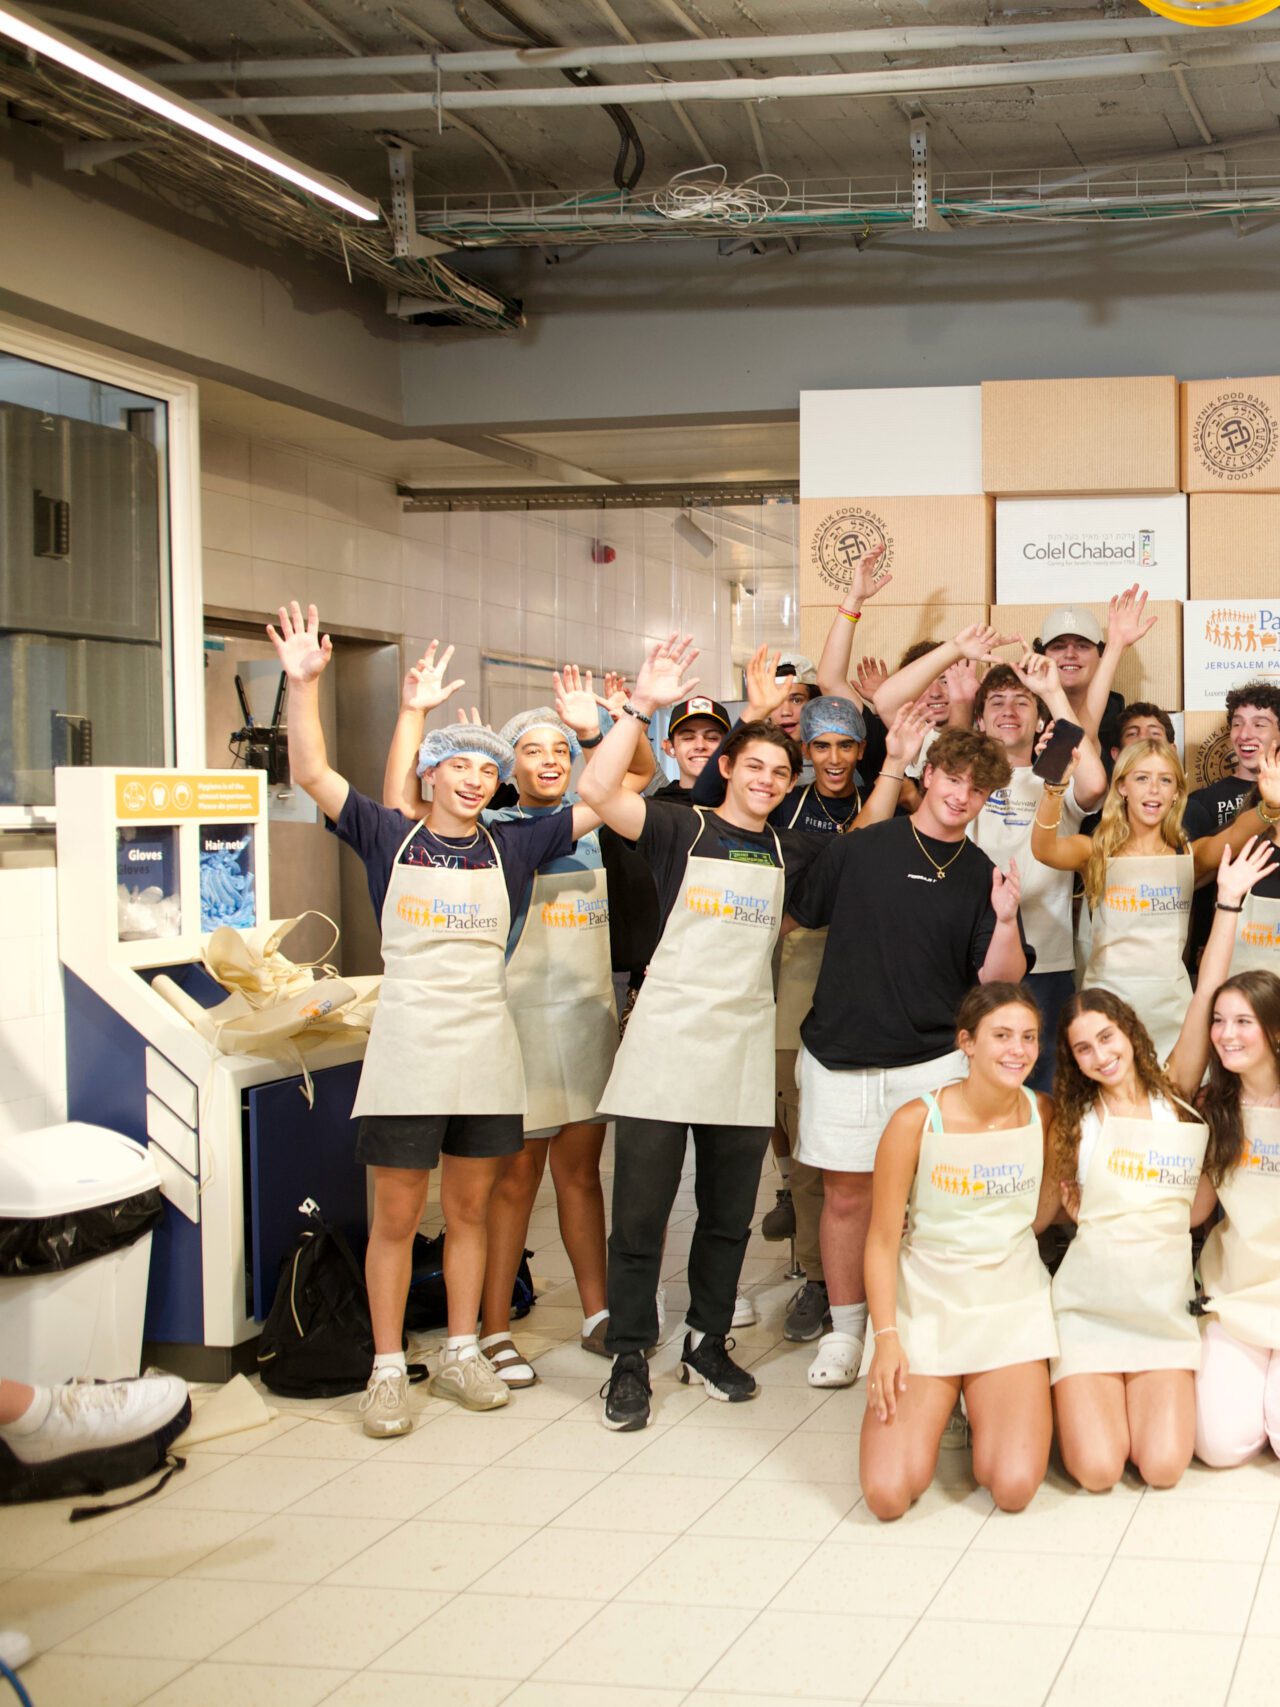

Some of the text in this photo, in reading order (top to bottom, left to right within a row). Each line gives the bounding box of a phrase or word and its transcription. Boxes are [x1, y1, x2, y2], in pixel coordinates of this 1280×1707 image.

[1193, 392, 1271, 452] BLAVATNIK FOOD BANK
[1200, 459, 1224, 479] BANK
[1227, 471, 1254, 480] FOOD
[811, 507, 888, 564] BLAVATNIK FOOD BANK
[1023, 541, 1135, 560] Colel Chabad
[1205, 661, 1264, 670] JERUSALEM
[205, 840, 245, 850] Hair nets
[128, 850, 162, 860] Gloves
[1140, 884, 1182, 899] Pantry
[432, 899, 481, 917] Pantry
[724, 890, 770, 912] Pantry
[446, 914, 498, 929] Packers
[588, 909, 609, 926] Pack
[1148, 1150, 1196, 1172] Pantry
[973, 1163, 1024, 1180] Pantry
[986, 1174, 1036, 1196] Packers
